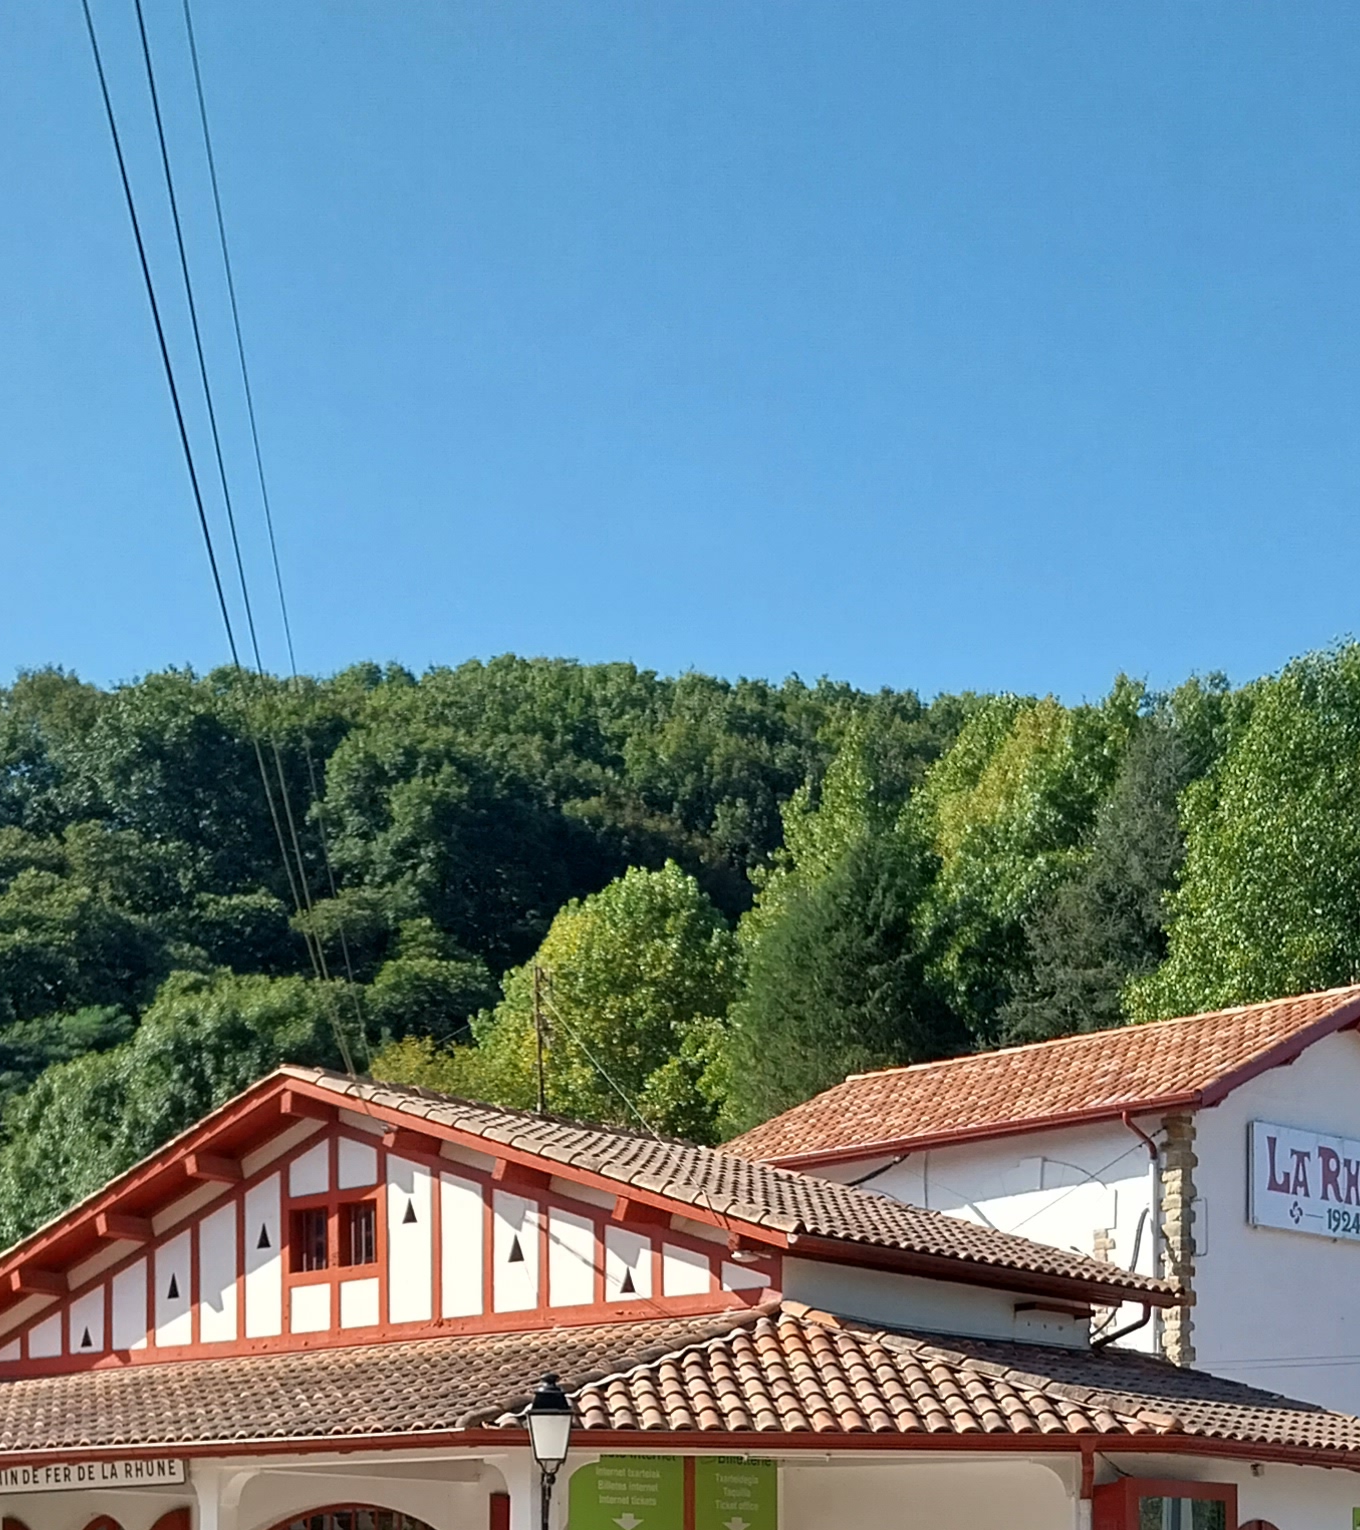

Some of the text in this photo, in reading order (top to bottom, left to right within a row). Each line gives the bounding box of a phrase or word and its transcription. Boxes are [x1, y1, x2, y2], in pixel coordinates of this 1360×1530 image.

[1266, 1135, 1311, 1198] LA
[1327, 1207, 1360, 1234] 1924
[23, 1468, 40, 1484] DE
[45, 1467, 72, 1484] FER
[78, 1464, 95, 1481] DE
[102, 1463, 118, 1479] LA
[125, 1460, 177, 1479] RHUNE
